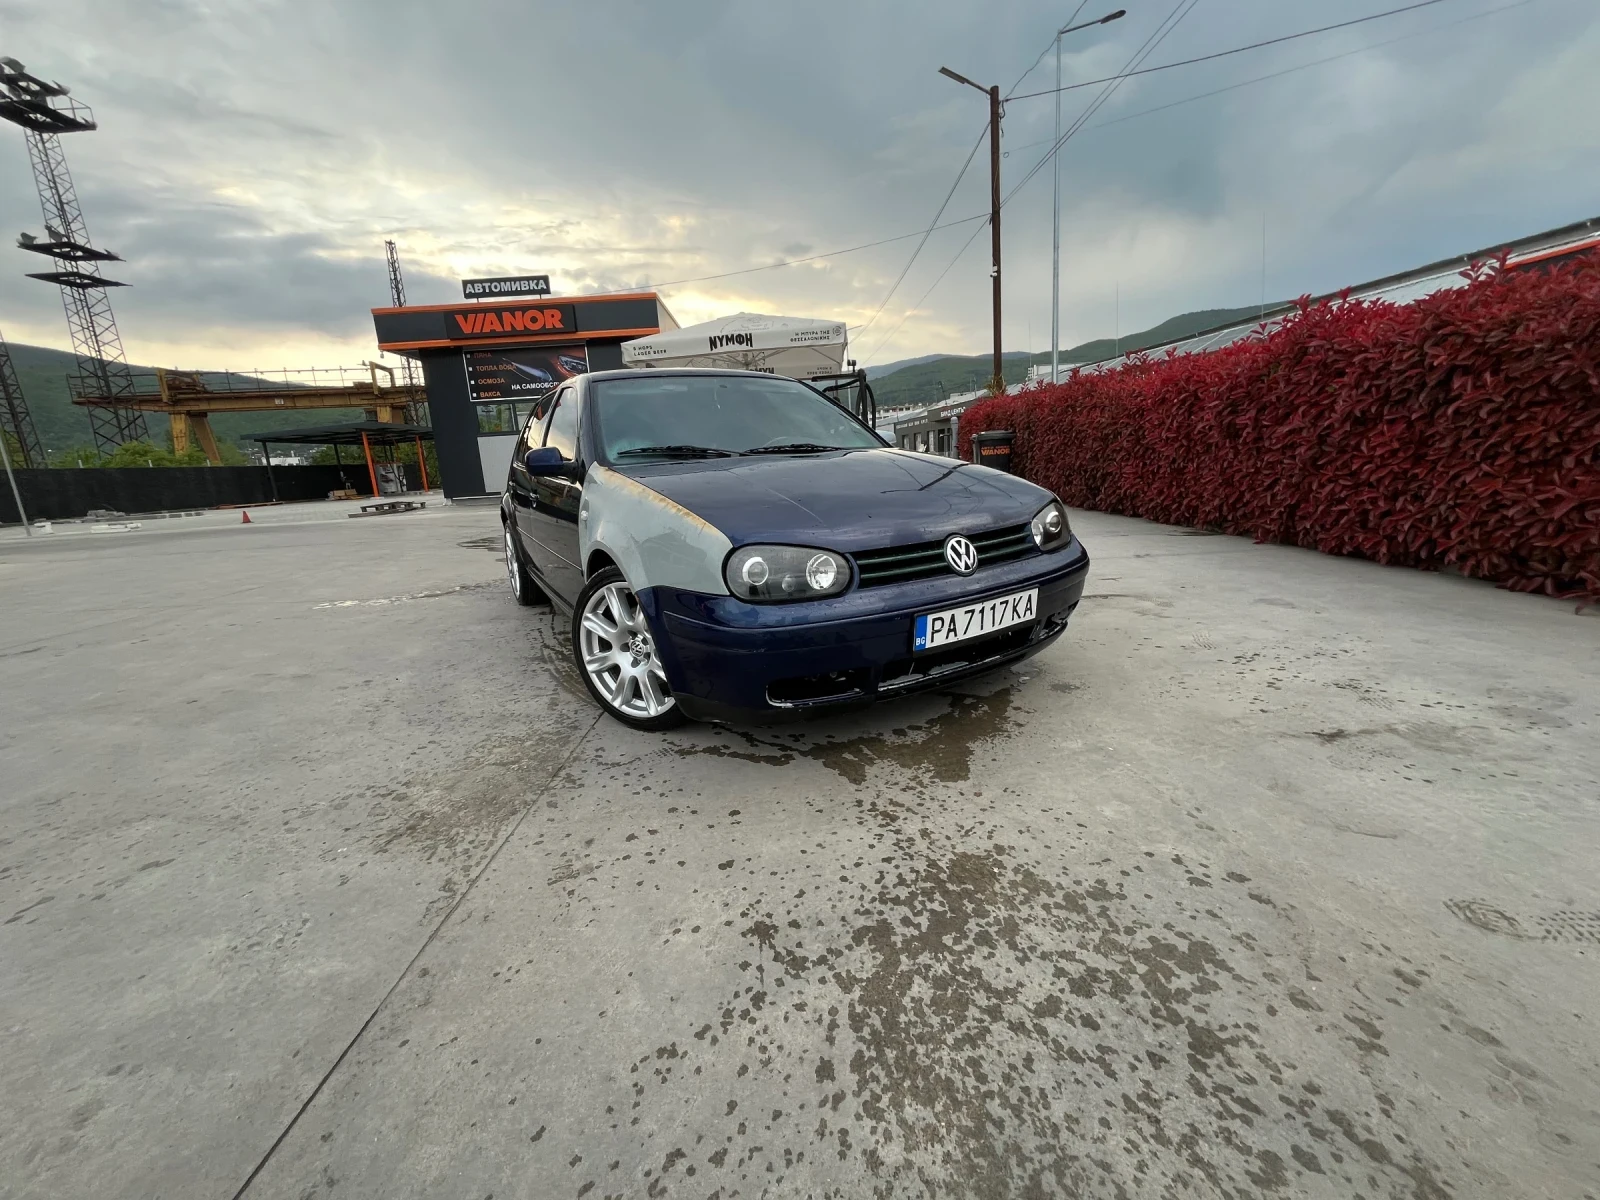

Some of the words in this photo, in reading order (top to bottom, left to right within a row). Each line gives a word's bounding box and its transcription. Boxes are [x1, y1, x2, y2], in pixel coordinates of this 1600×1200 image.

[465, 279, 547, 294] АВТОМИВКА
[454, 308, 564, 334] VIANOR
[475, 364, 498, 372] ТОПЛА
[930, 593, 1033, 643] PA7117KA
[915, 636, 926, 646] BG
